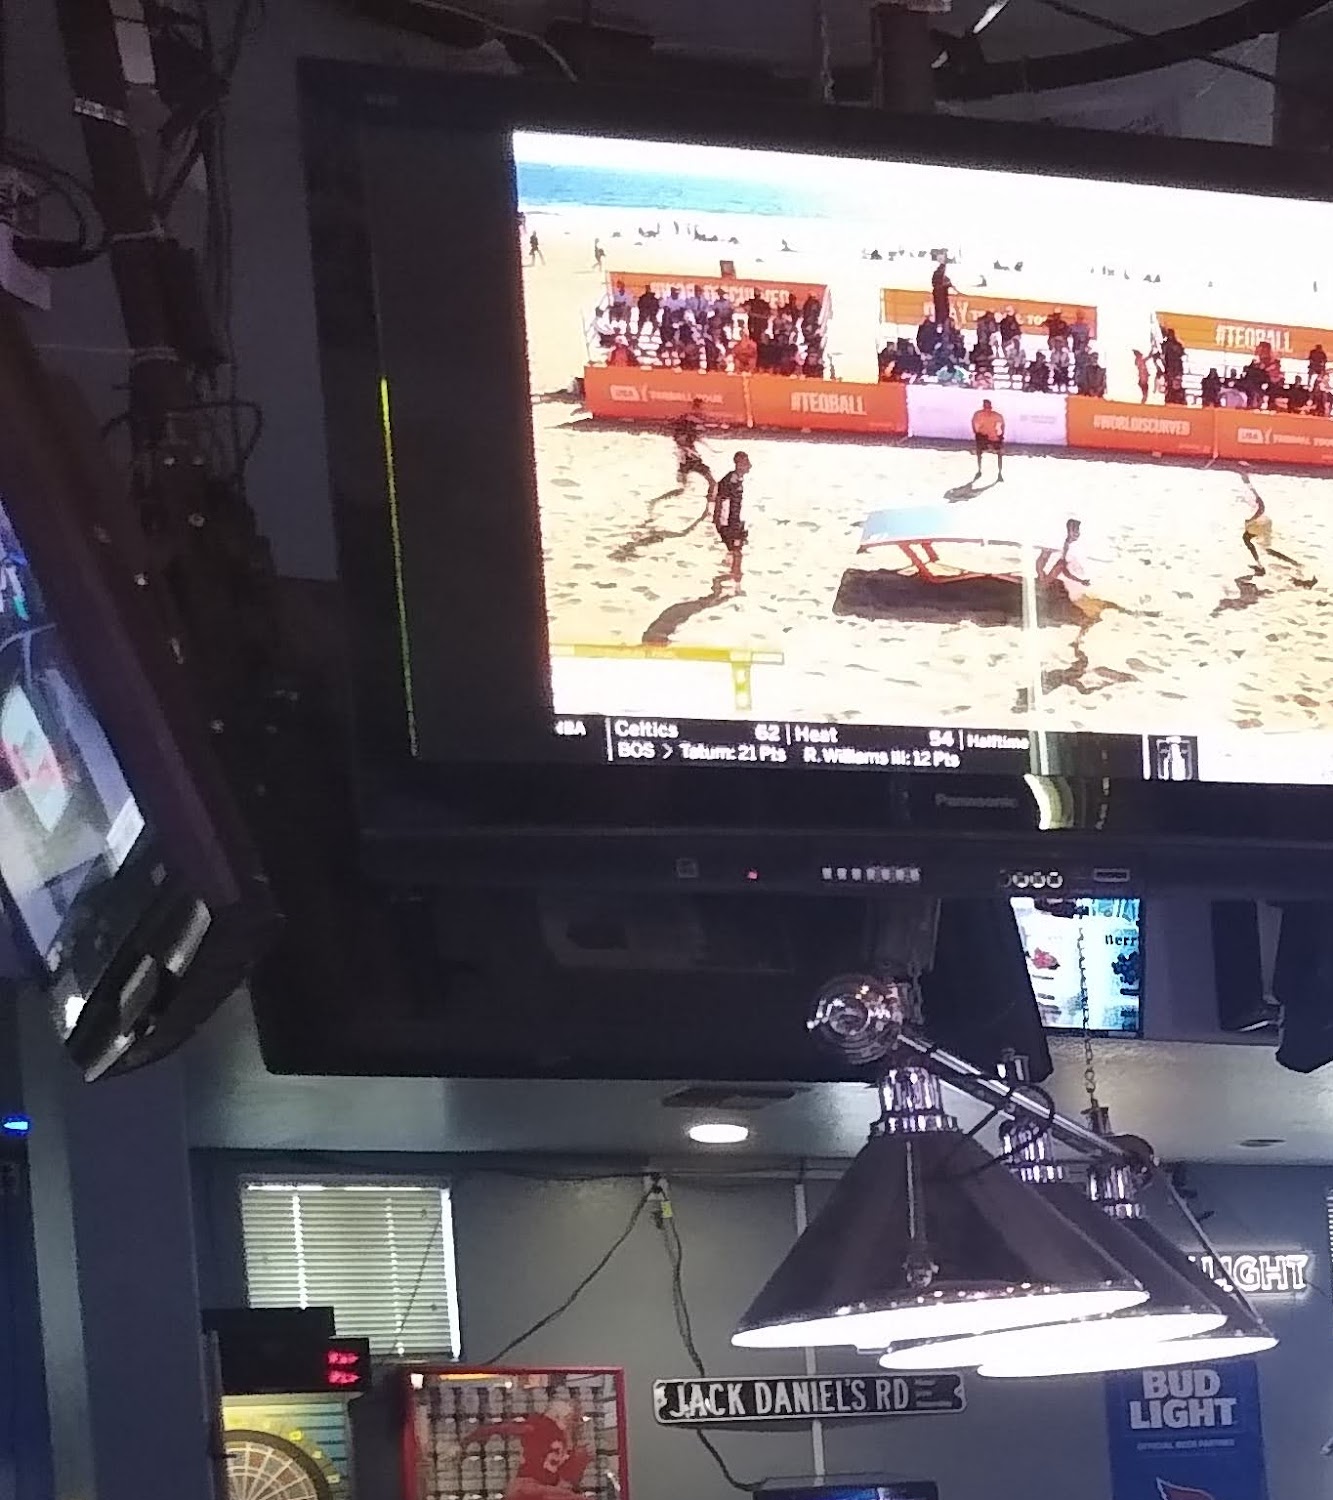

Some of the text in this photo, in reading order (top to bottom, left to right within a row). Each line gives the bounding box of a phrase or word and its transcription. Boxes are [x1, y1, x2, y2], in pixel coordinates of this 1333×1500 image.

[791, 391, 867, 416] #TEQBALL
[614, 719, 679, 738] Celtics
[794, 725, 838, 743] Heat
[617, 741, 656, 759] BOS
[759, 746, 787, 763] Pts
[933, 751, 960, 768] Pts
[669, 1382, 746, 1418] JACK
[753, 1379, 867, 1415] DANIEL'S
[875, 1378, 909, 1411] RD
[1142, 1368, 1221, 1400] BUD
[1129, 1397, 1237, 1430] LIGHT
